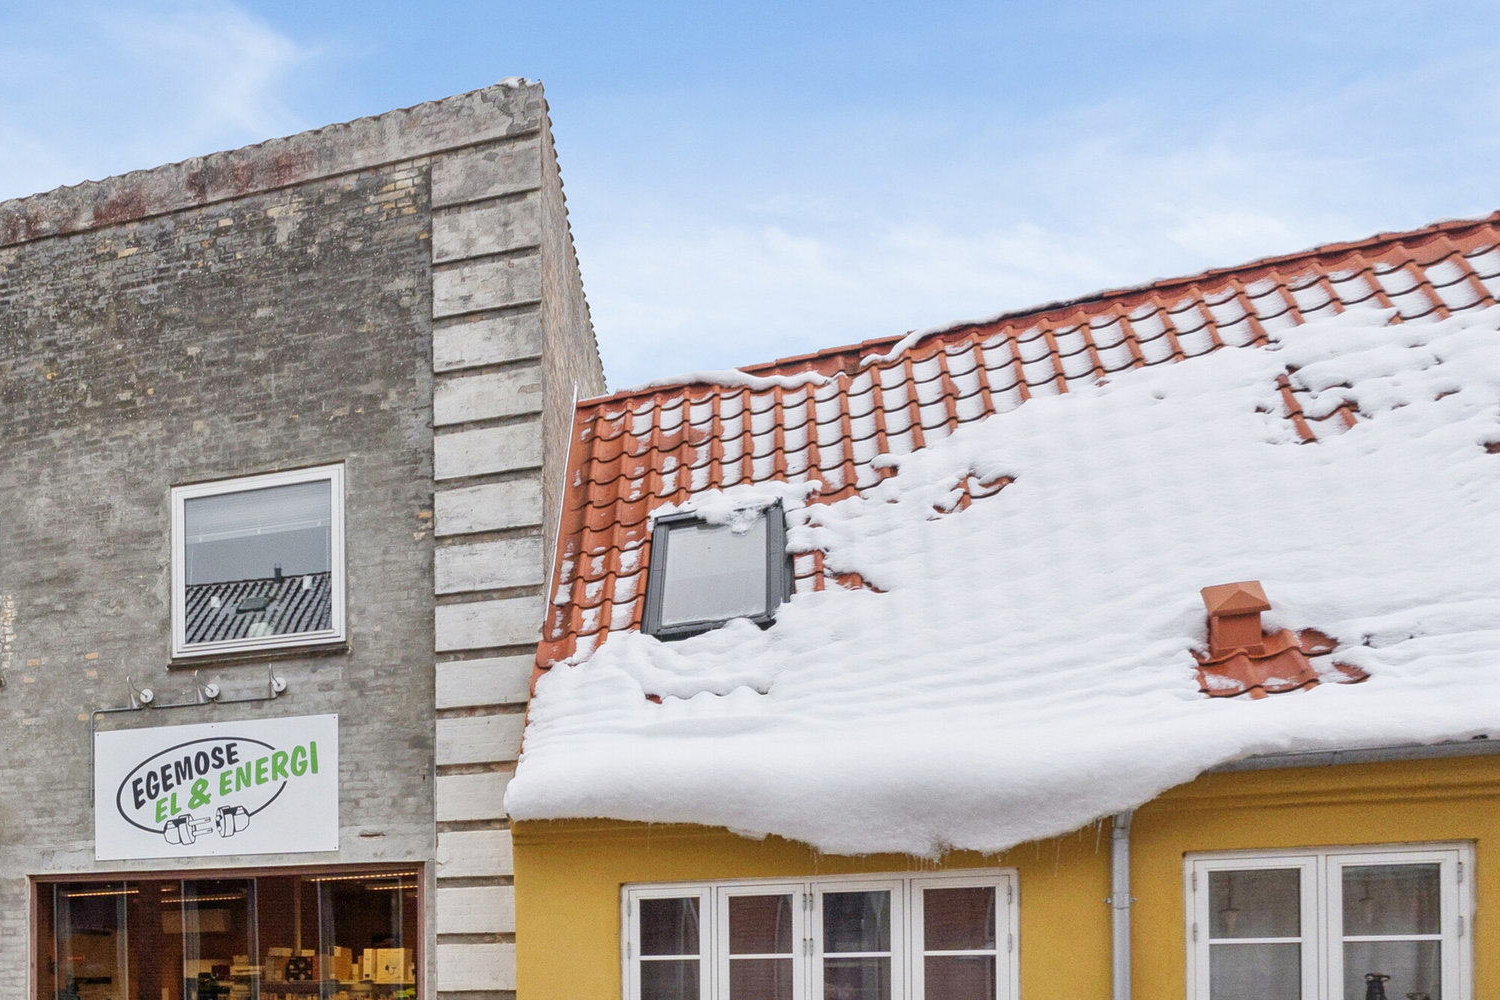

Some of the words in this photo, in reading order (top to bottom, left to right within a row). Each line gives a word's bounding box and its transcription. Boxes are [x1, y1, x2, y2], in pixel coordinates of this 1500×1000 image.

[132, 742, 239, 810] EGEMOSE
[155, 792, 182, 823] EL
[188, 777, 212, 810] &
[219, 741, 319, 796] ENERGI
